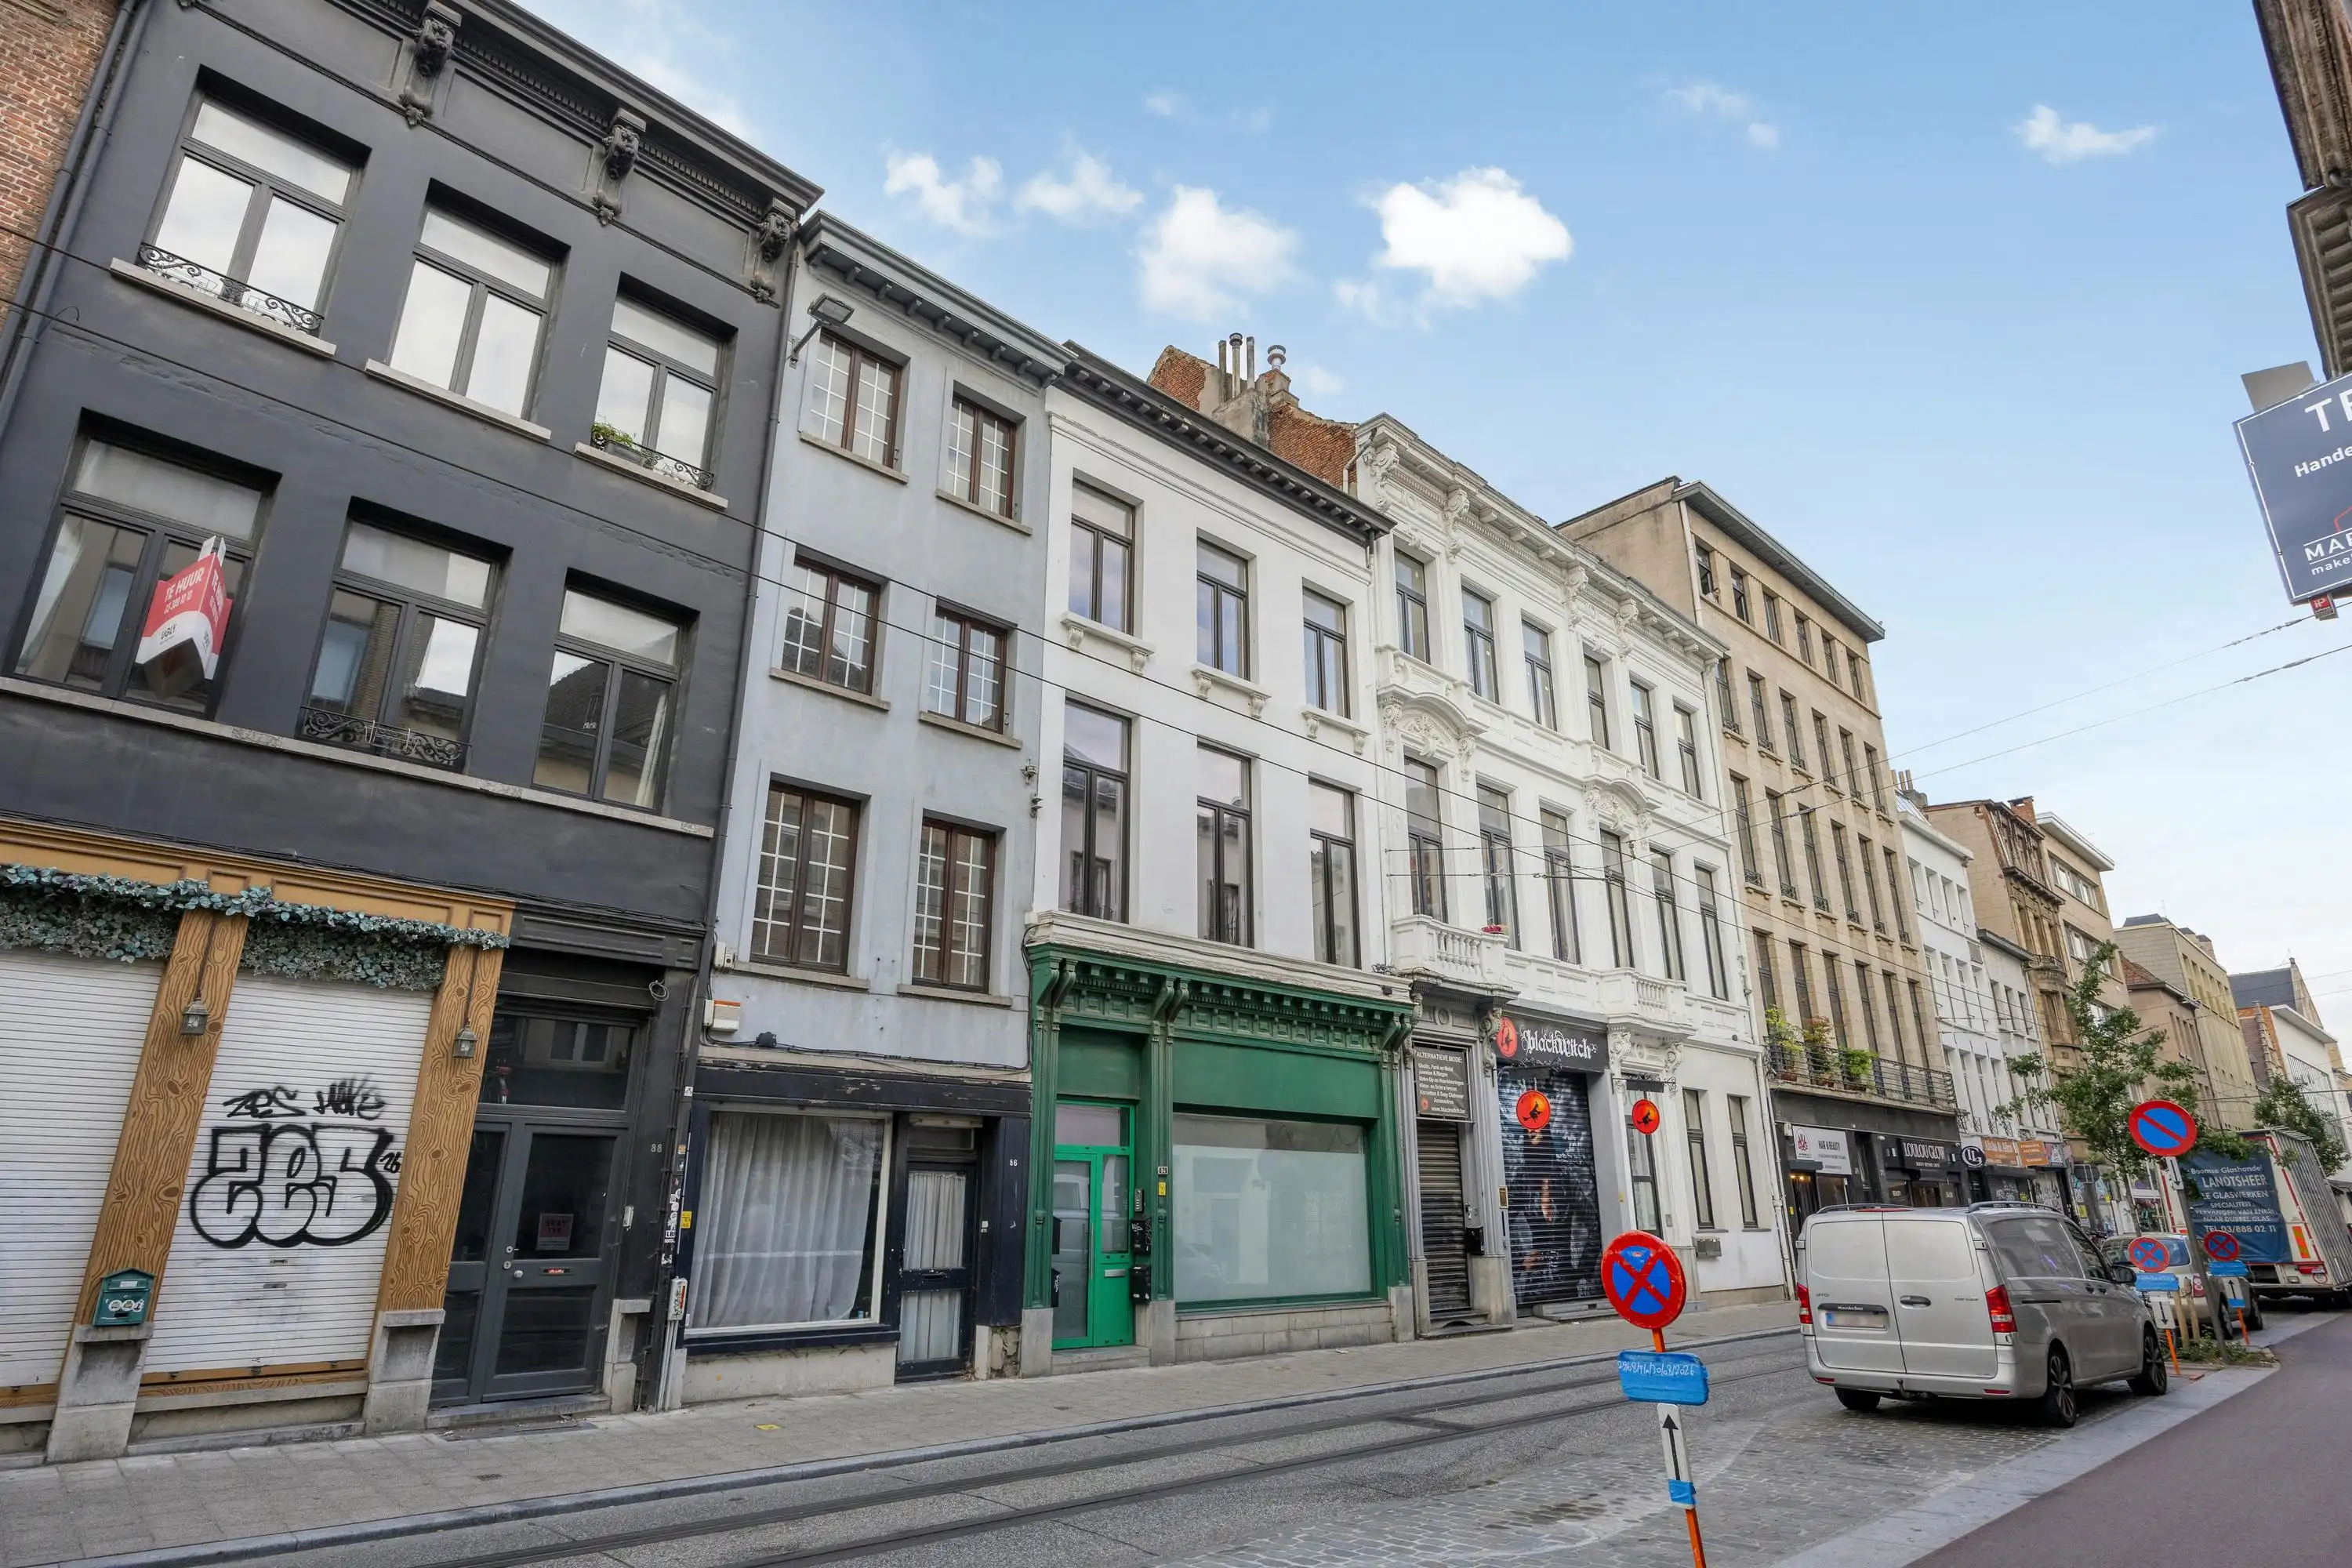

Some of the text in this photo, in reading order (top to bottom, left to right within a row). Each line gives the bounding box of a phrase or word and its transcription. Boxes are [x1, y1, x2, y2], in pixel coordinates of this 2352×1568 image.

[2311, 554, 2352, 575] make
[165, 566, 205, 603] TE HUUR
[161, 623, 177, 640] UGLY
[1417, 1051, 1448, 1061] ALTERNATIEVE
[1903, 1142, 1945, 1160] LOULOU GLOW
[2201, 1174, 2267, 1188] LANDTSHEER
[2212, 1191, 2269, 1200] GLASWERKEN
[2220, 1225, 2252, 1233] 03/888
